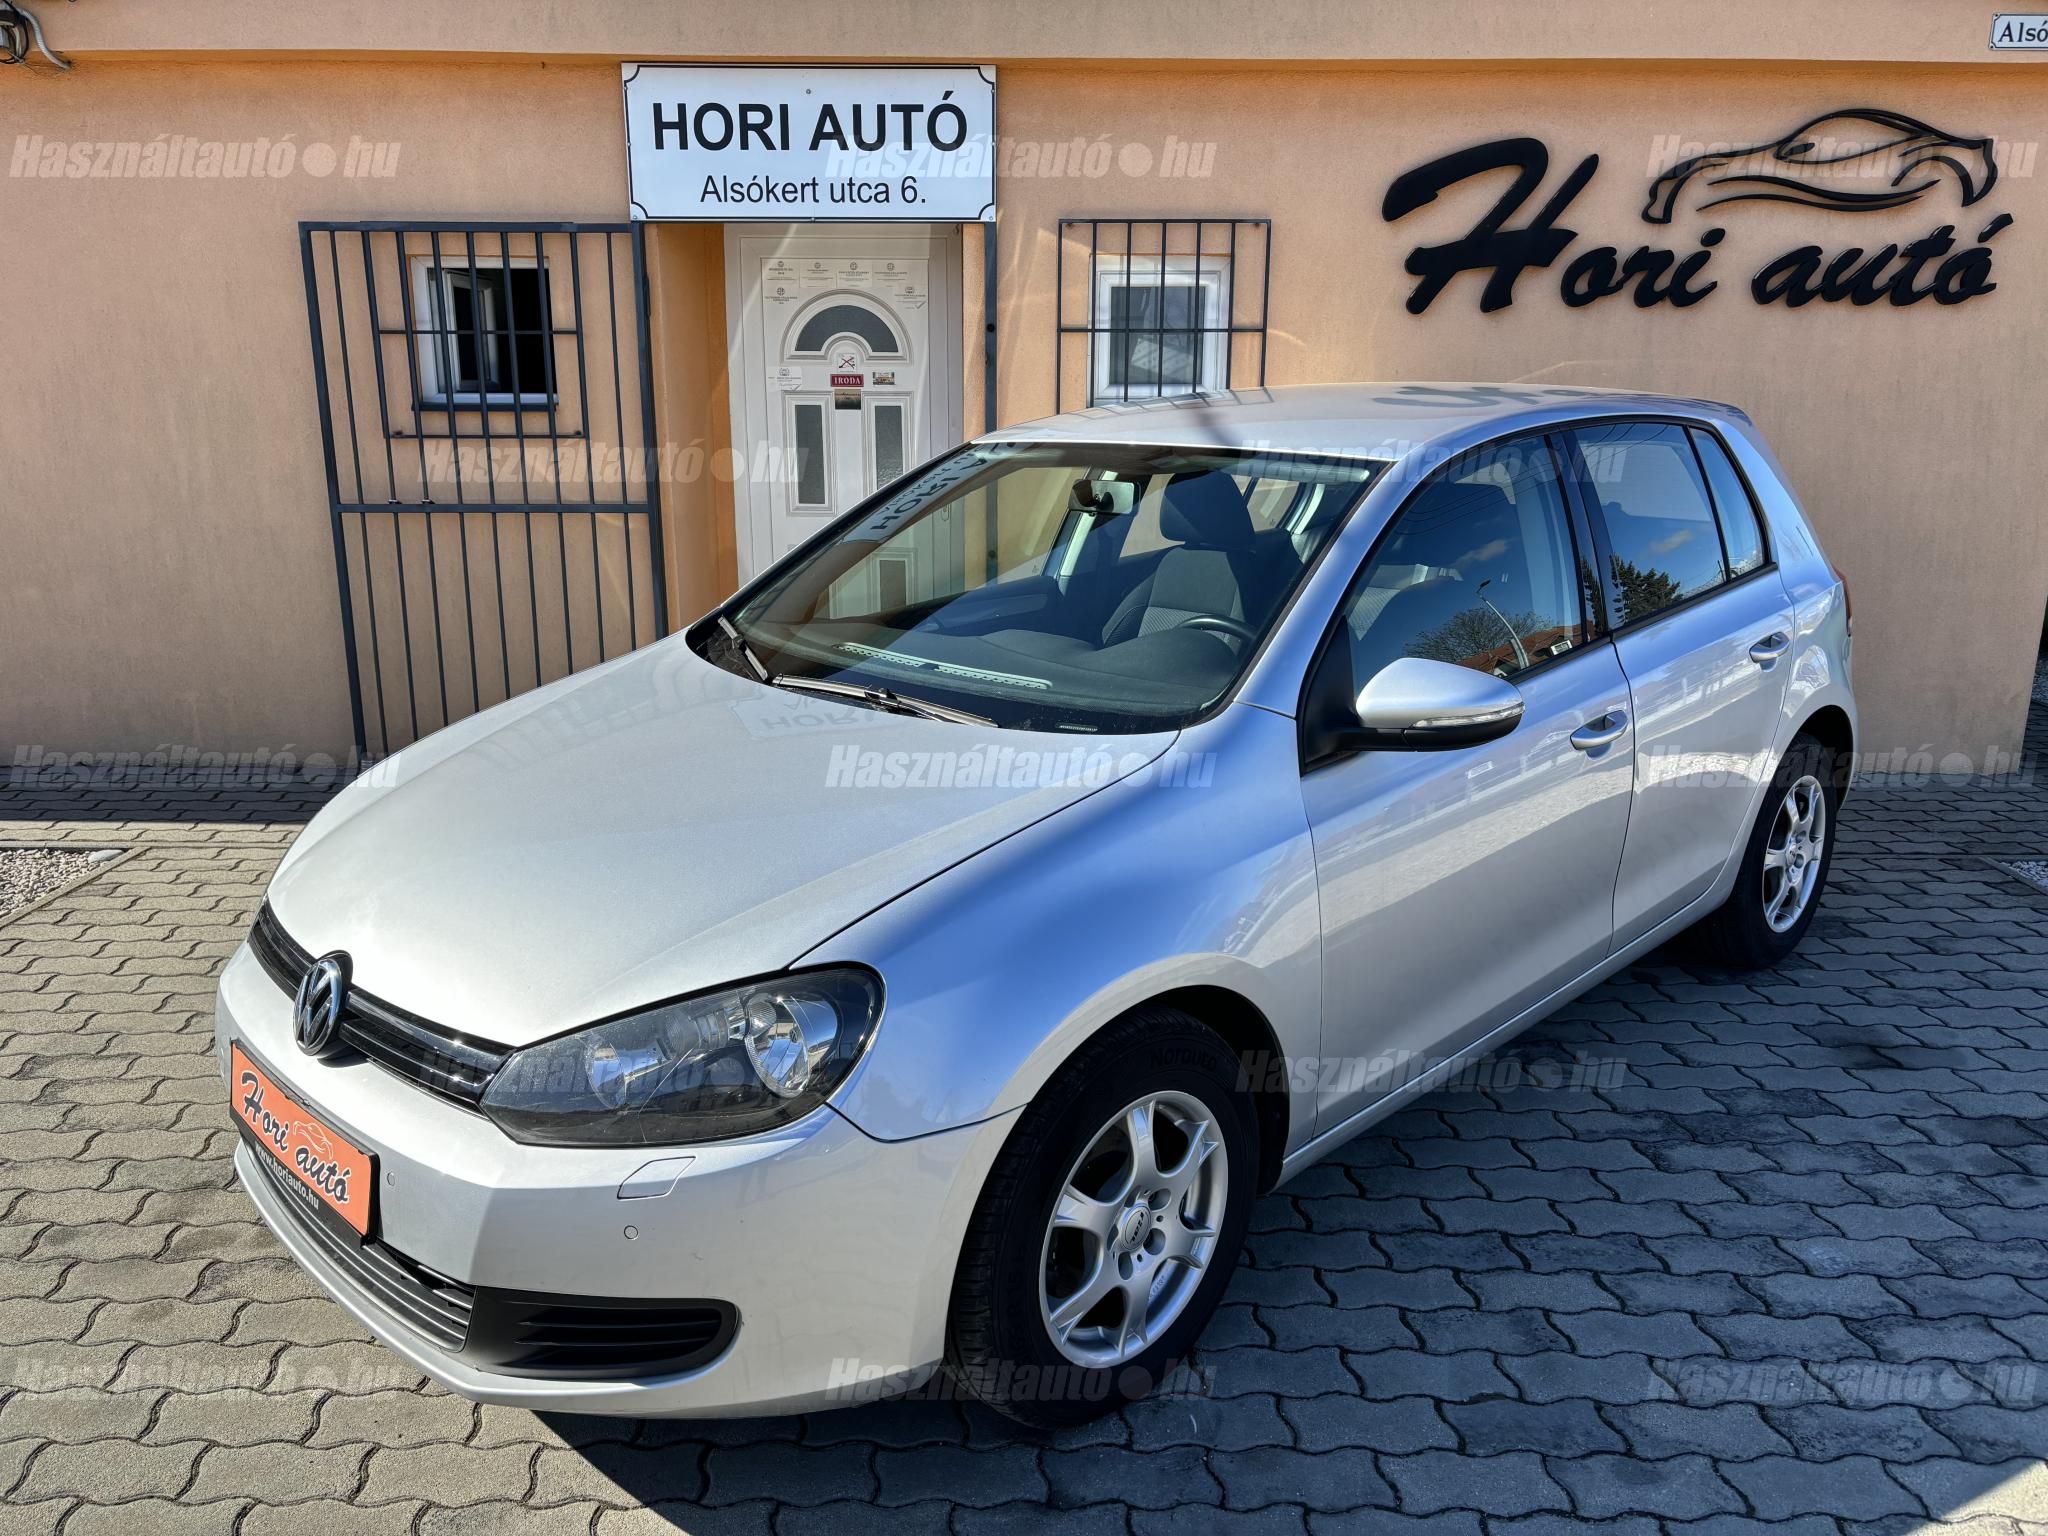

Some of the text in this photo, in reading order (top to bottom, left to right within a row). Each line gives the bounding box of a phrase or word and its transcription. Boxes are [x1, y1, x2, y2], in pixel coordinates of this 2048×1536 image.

[1997, 20, 2048, 42] Alsó
[652, 91, 967, 151] HORI AUTÓ
[700, 175, 926, 204] Alsókert utca 6.
[1383, 137, 2014, 314] Hori autó
[834, 375, 861, 385] IRODA
[241, 1070, 351, 1204] Hori autó
[254, 1140, 319, 1210] www.horiauto.hu
